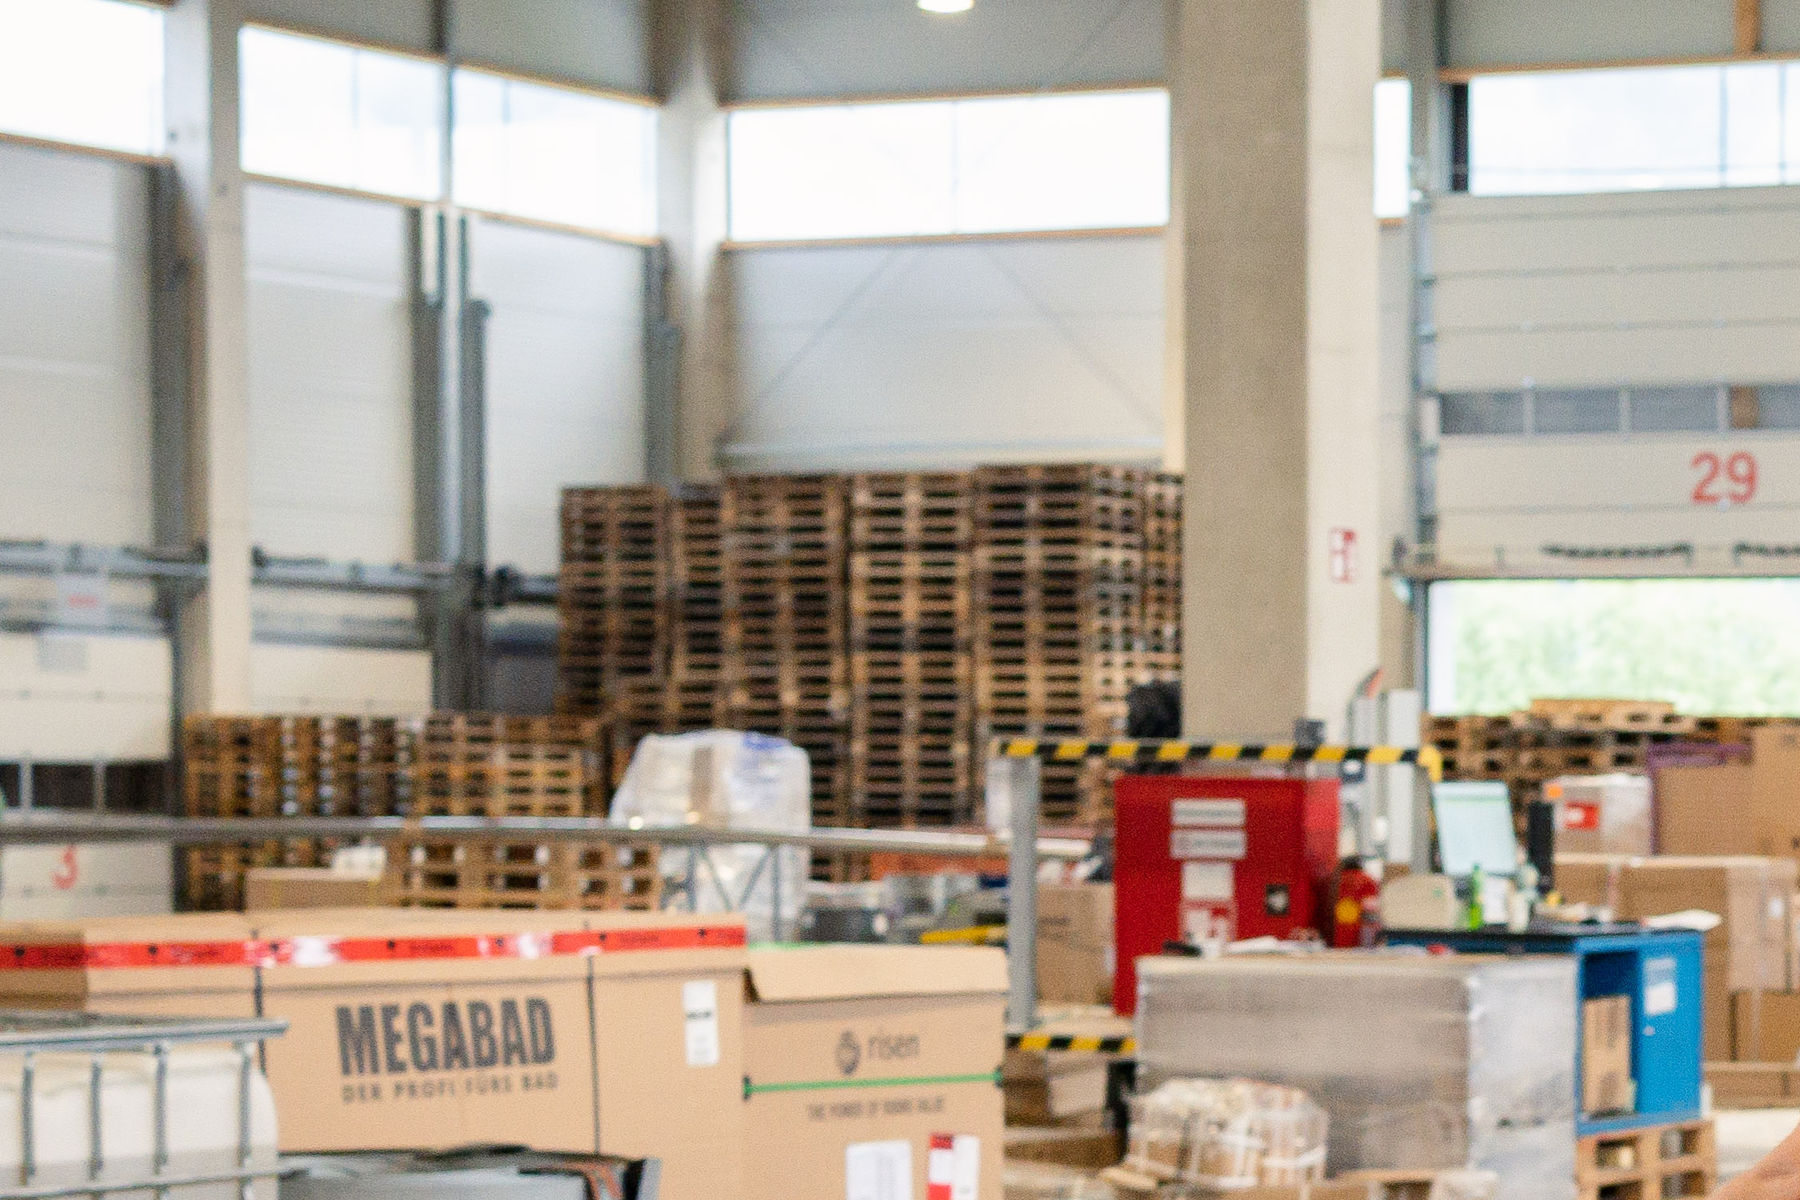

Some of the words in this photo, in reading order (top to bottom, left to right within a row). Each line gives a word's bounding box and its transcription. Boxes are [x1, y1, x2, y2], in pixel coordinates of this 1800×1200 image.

[1690, 451, 1758, 503] 29
[336, 995, 556, 1075] MEGABAD
[521, 1070, 558, 1092] BAD
